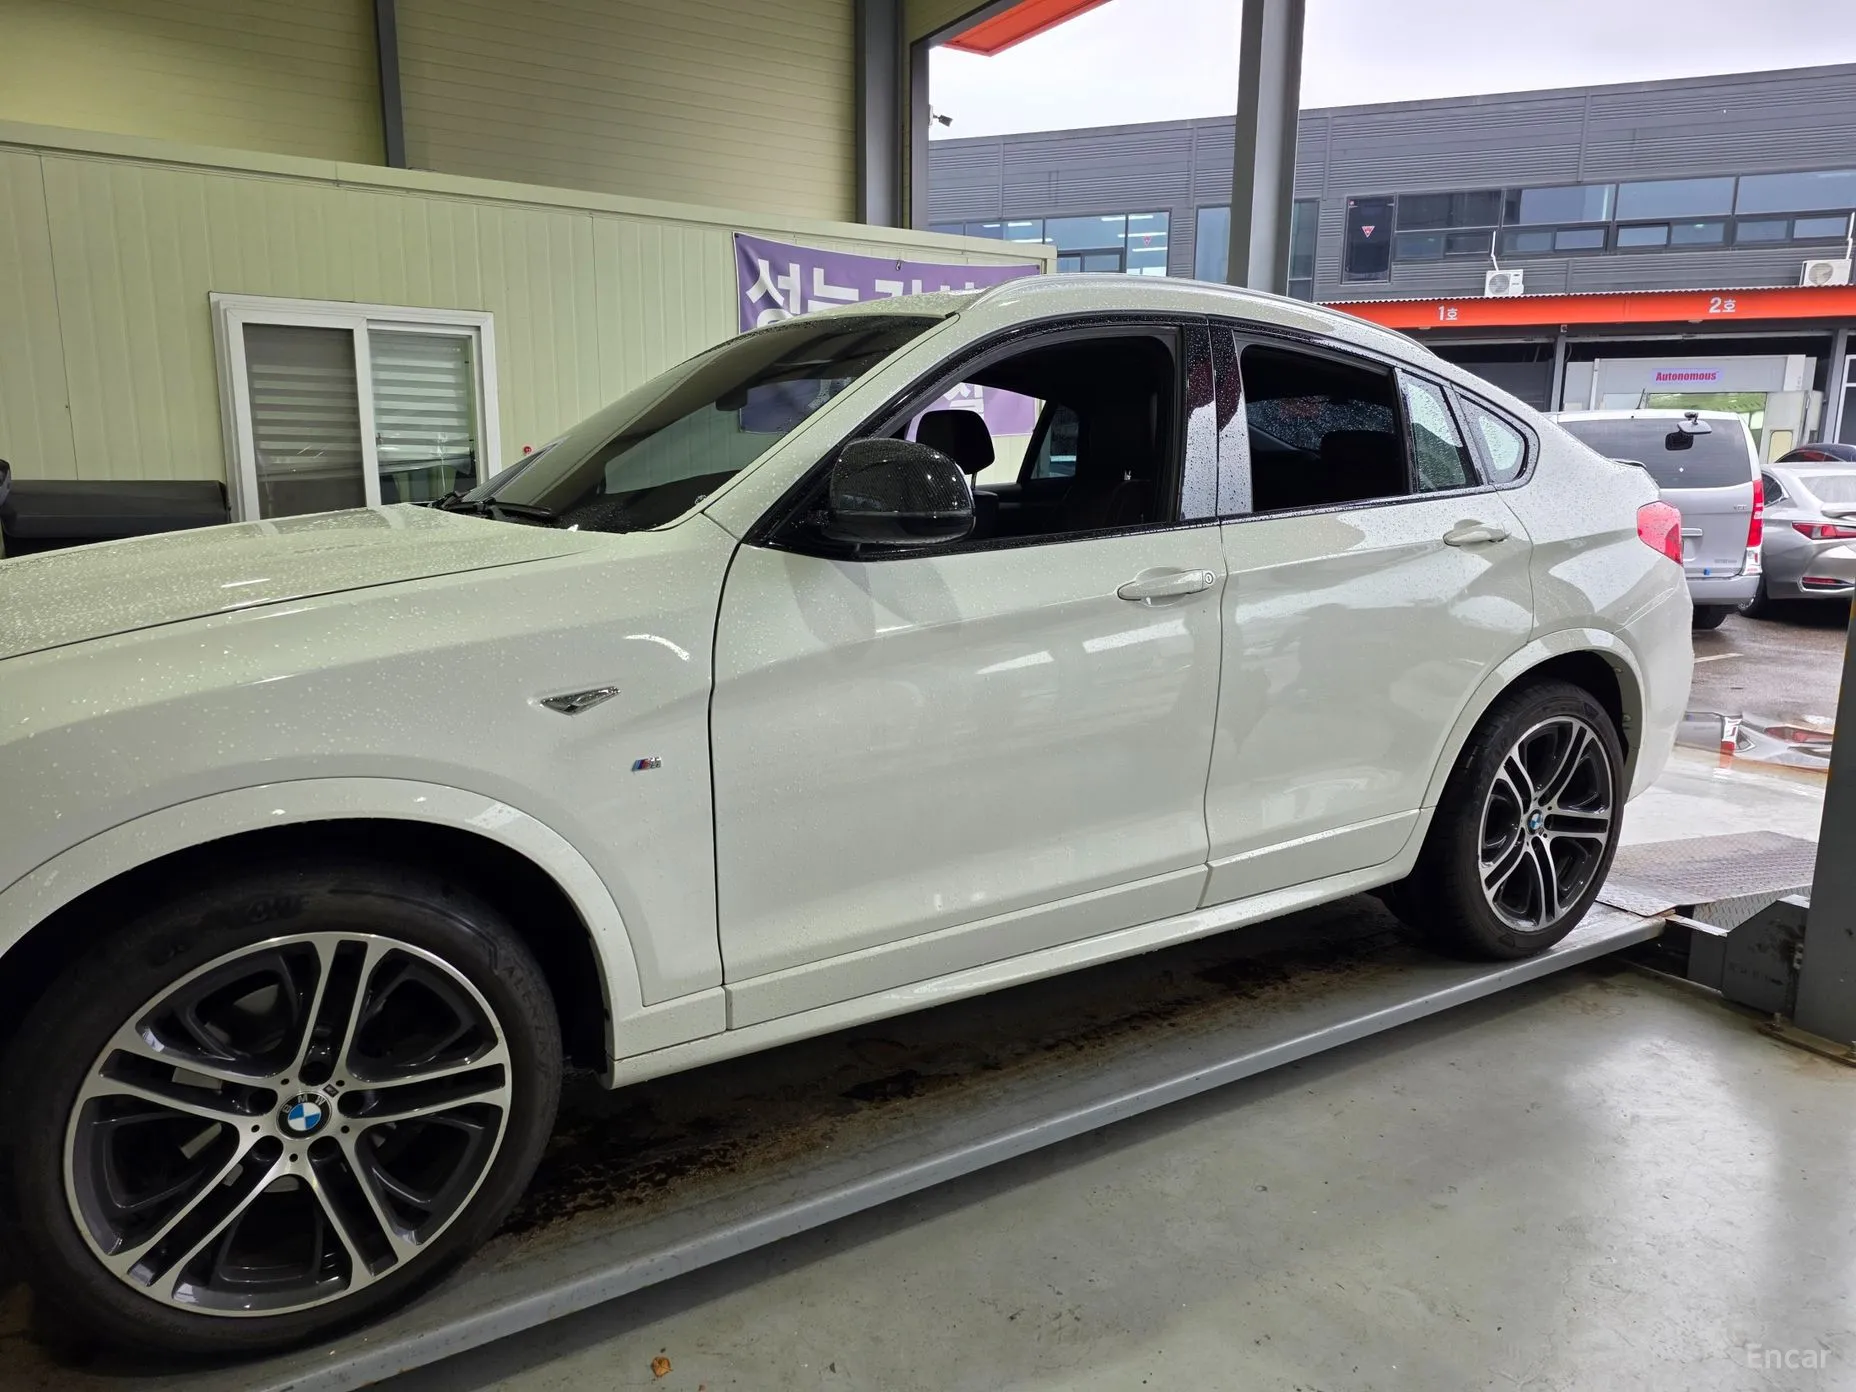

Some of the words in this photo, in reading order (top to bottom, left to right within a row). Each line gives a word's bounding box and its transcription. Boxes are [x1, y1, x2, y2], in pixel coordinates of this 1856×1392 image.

[1438, 305, 1458, 321] 1호
[1709, 297, 1736, 313] 2호
[1655, 371, 1717, 382] Autonomous
